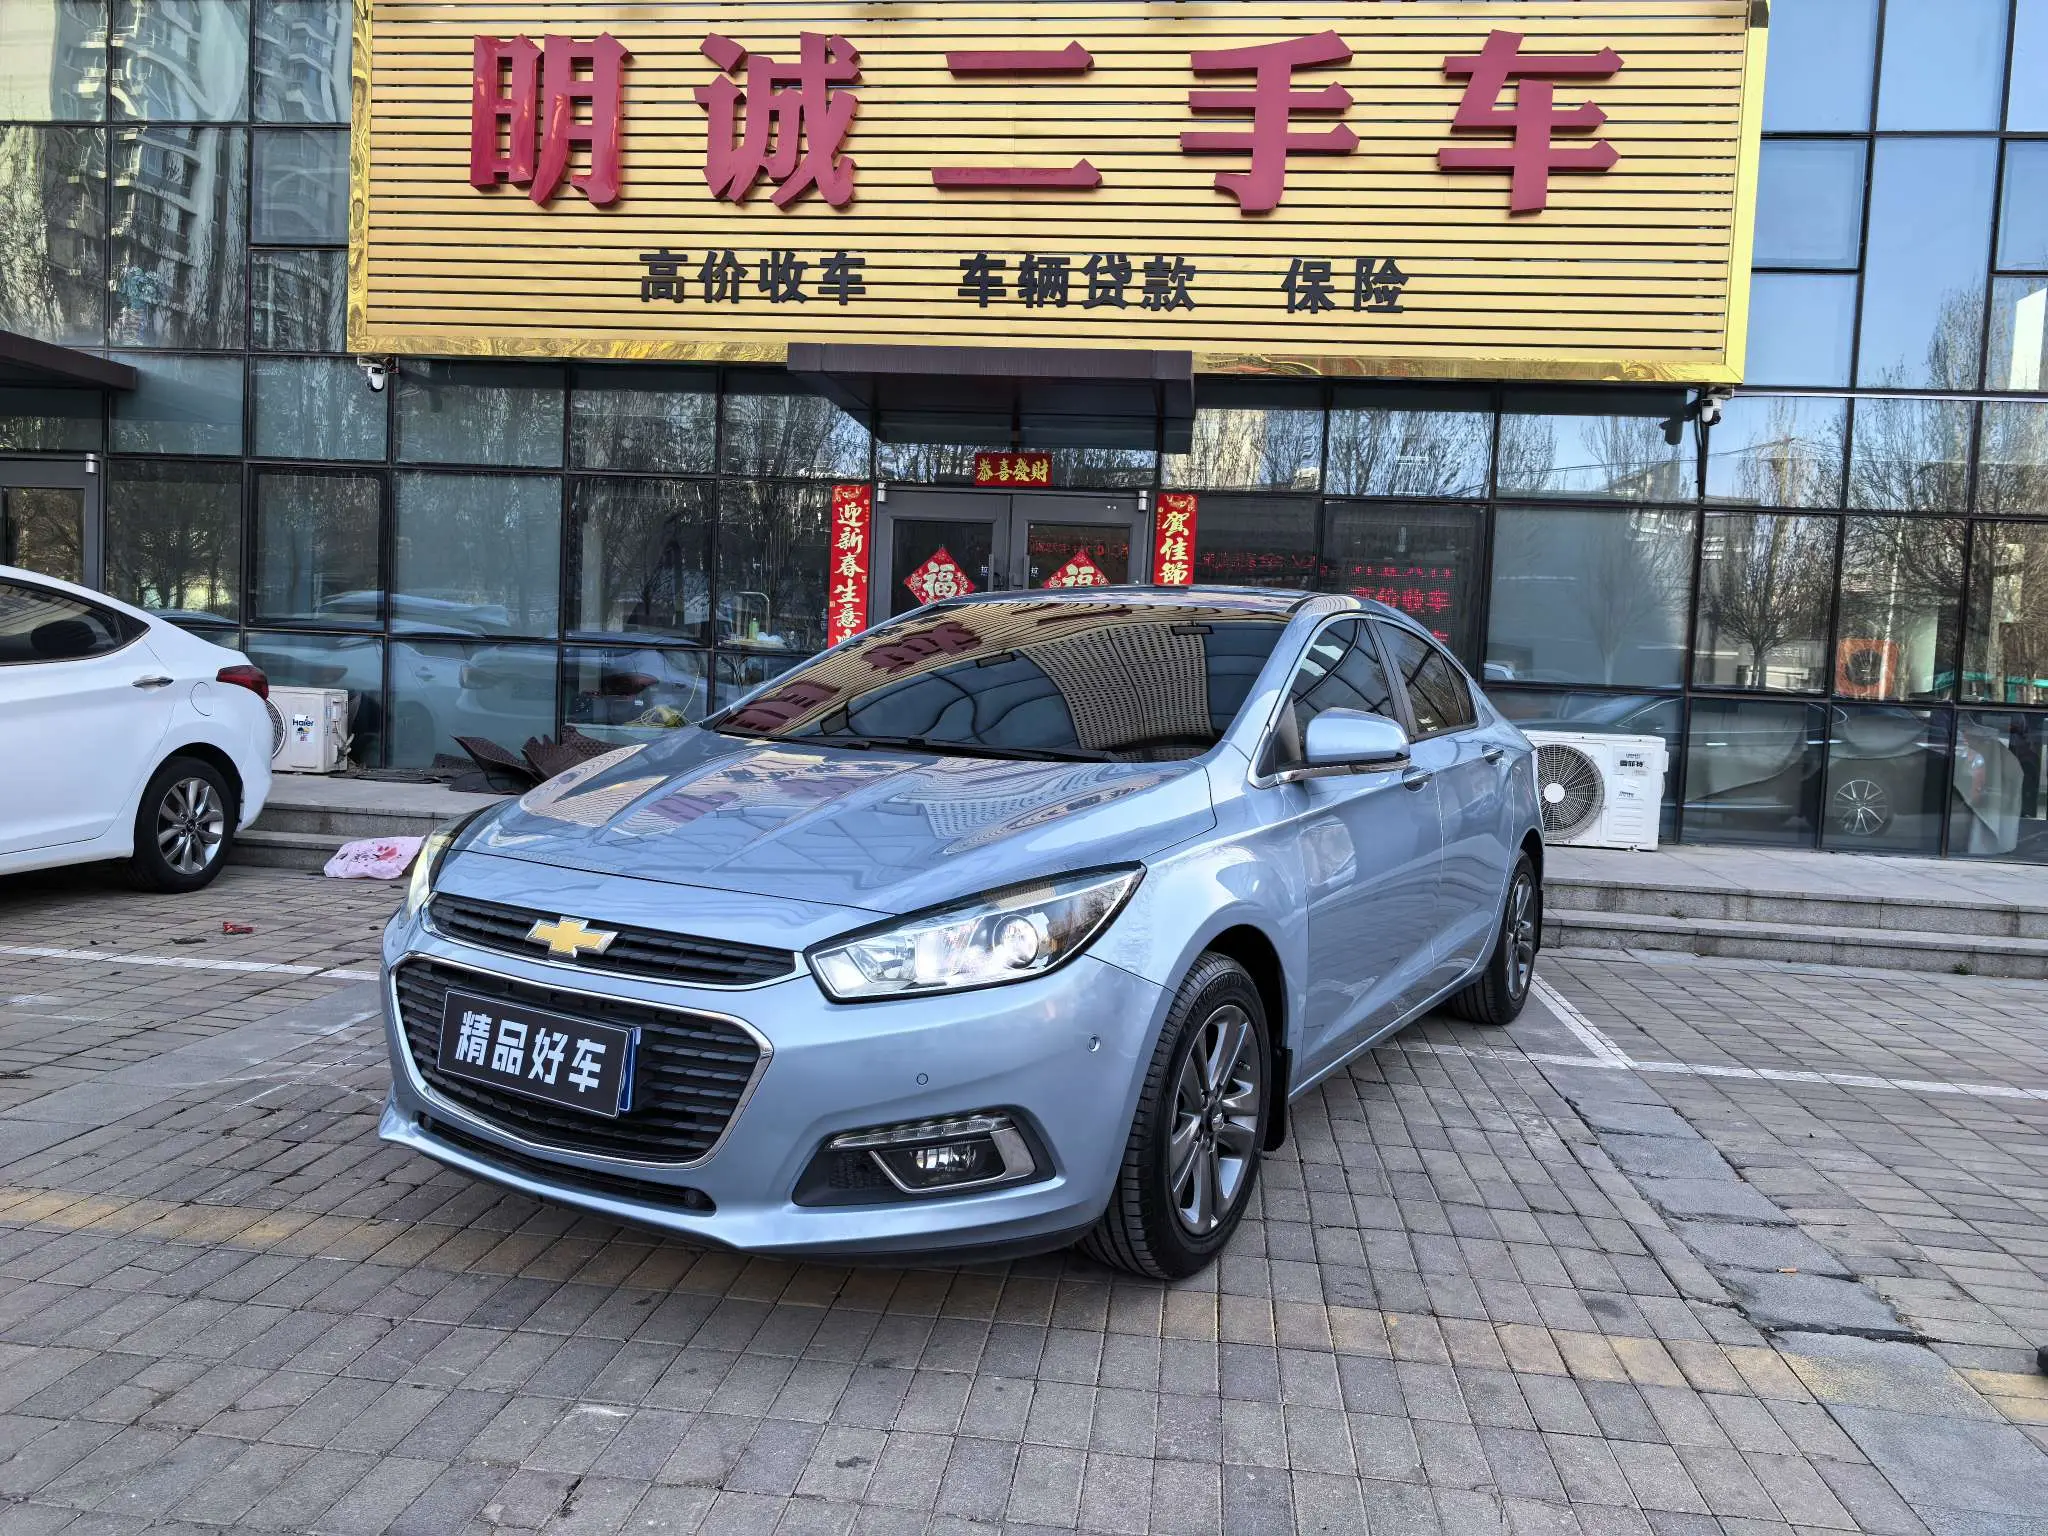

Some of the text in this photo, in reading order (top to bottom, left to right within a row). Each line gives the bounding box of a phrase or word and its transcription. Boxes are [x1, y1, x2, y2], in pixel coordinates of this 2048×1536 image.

[471, 29, 1624, 216] 明诚二手车
[639, 250, 1410, 314] 高价收车 车辆贷款 保险
[923, 561, 958, 598] 福
[292, 715, 314, 726] Haier
[454, 1010, 607, 1093] 精品好车
